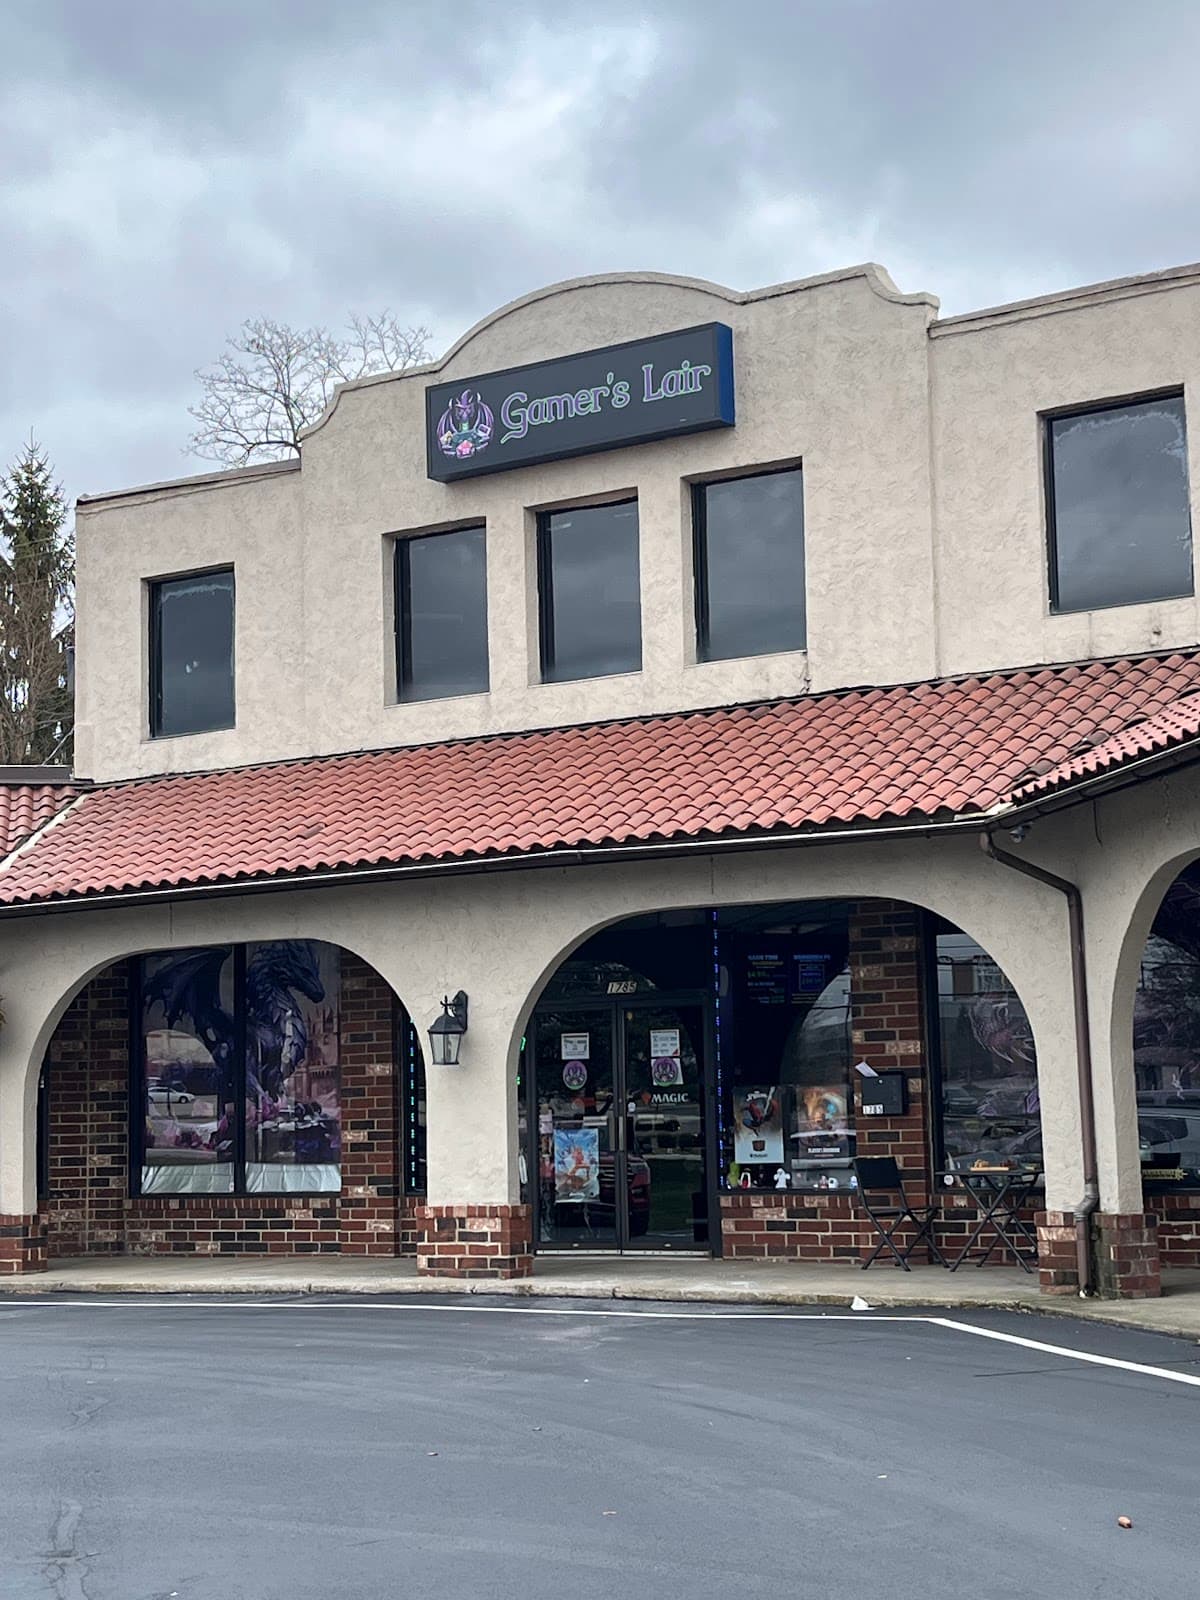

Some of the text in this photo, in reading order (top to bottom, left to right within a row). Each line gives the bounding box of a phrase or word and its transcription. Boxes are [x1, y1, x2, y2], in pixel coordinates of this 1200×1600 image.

[501, 360, 711, 443] Gamer's Lair
[609, 981, 636, 993] 1785
[651, 1093, 688, 1103] MAGIC
